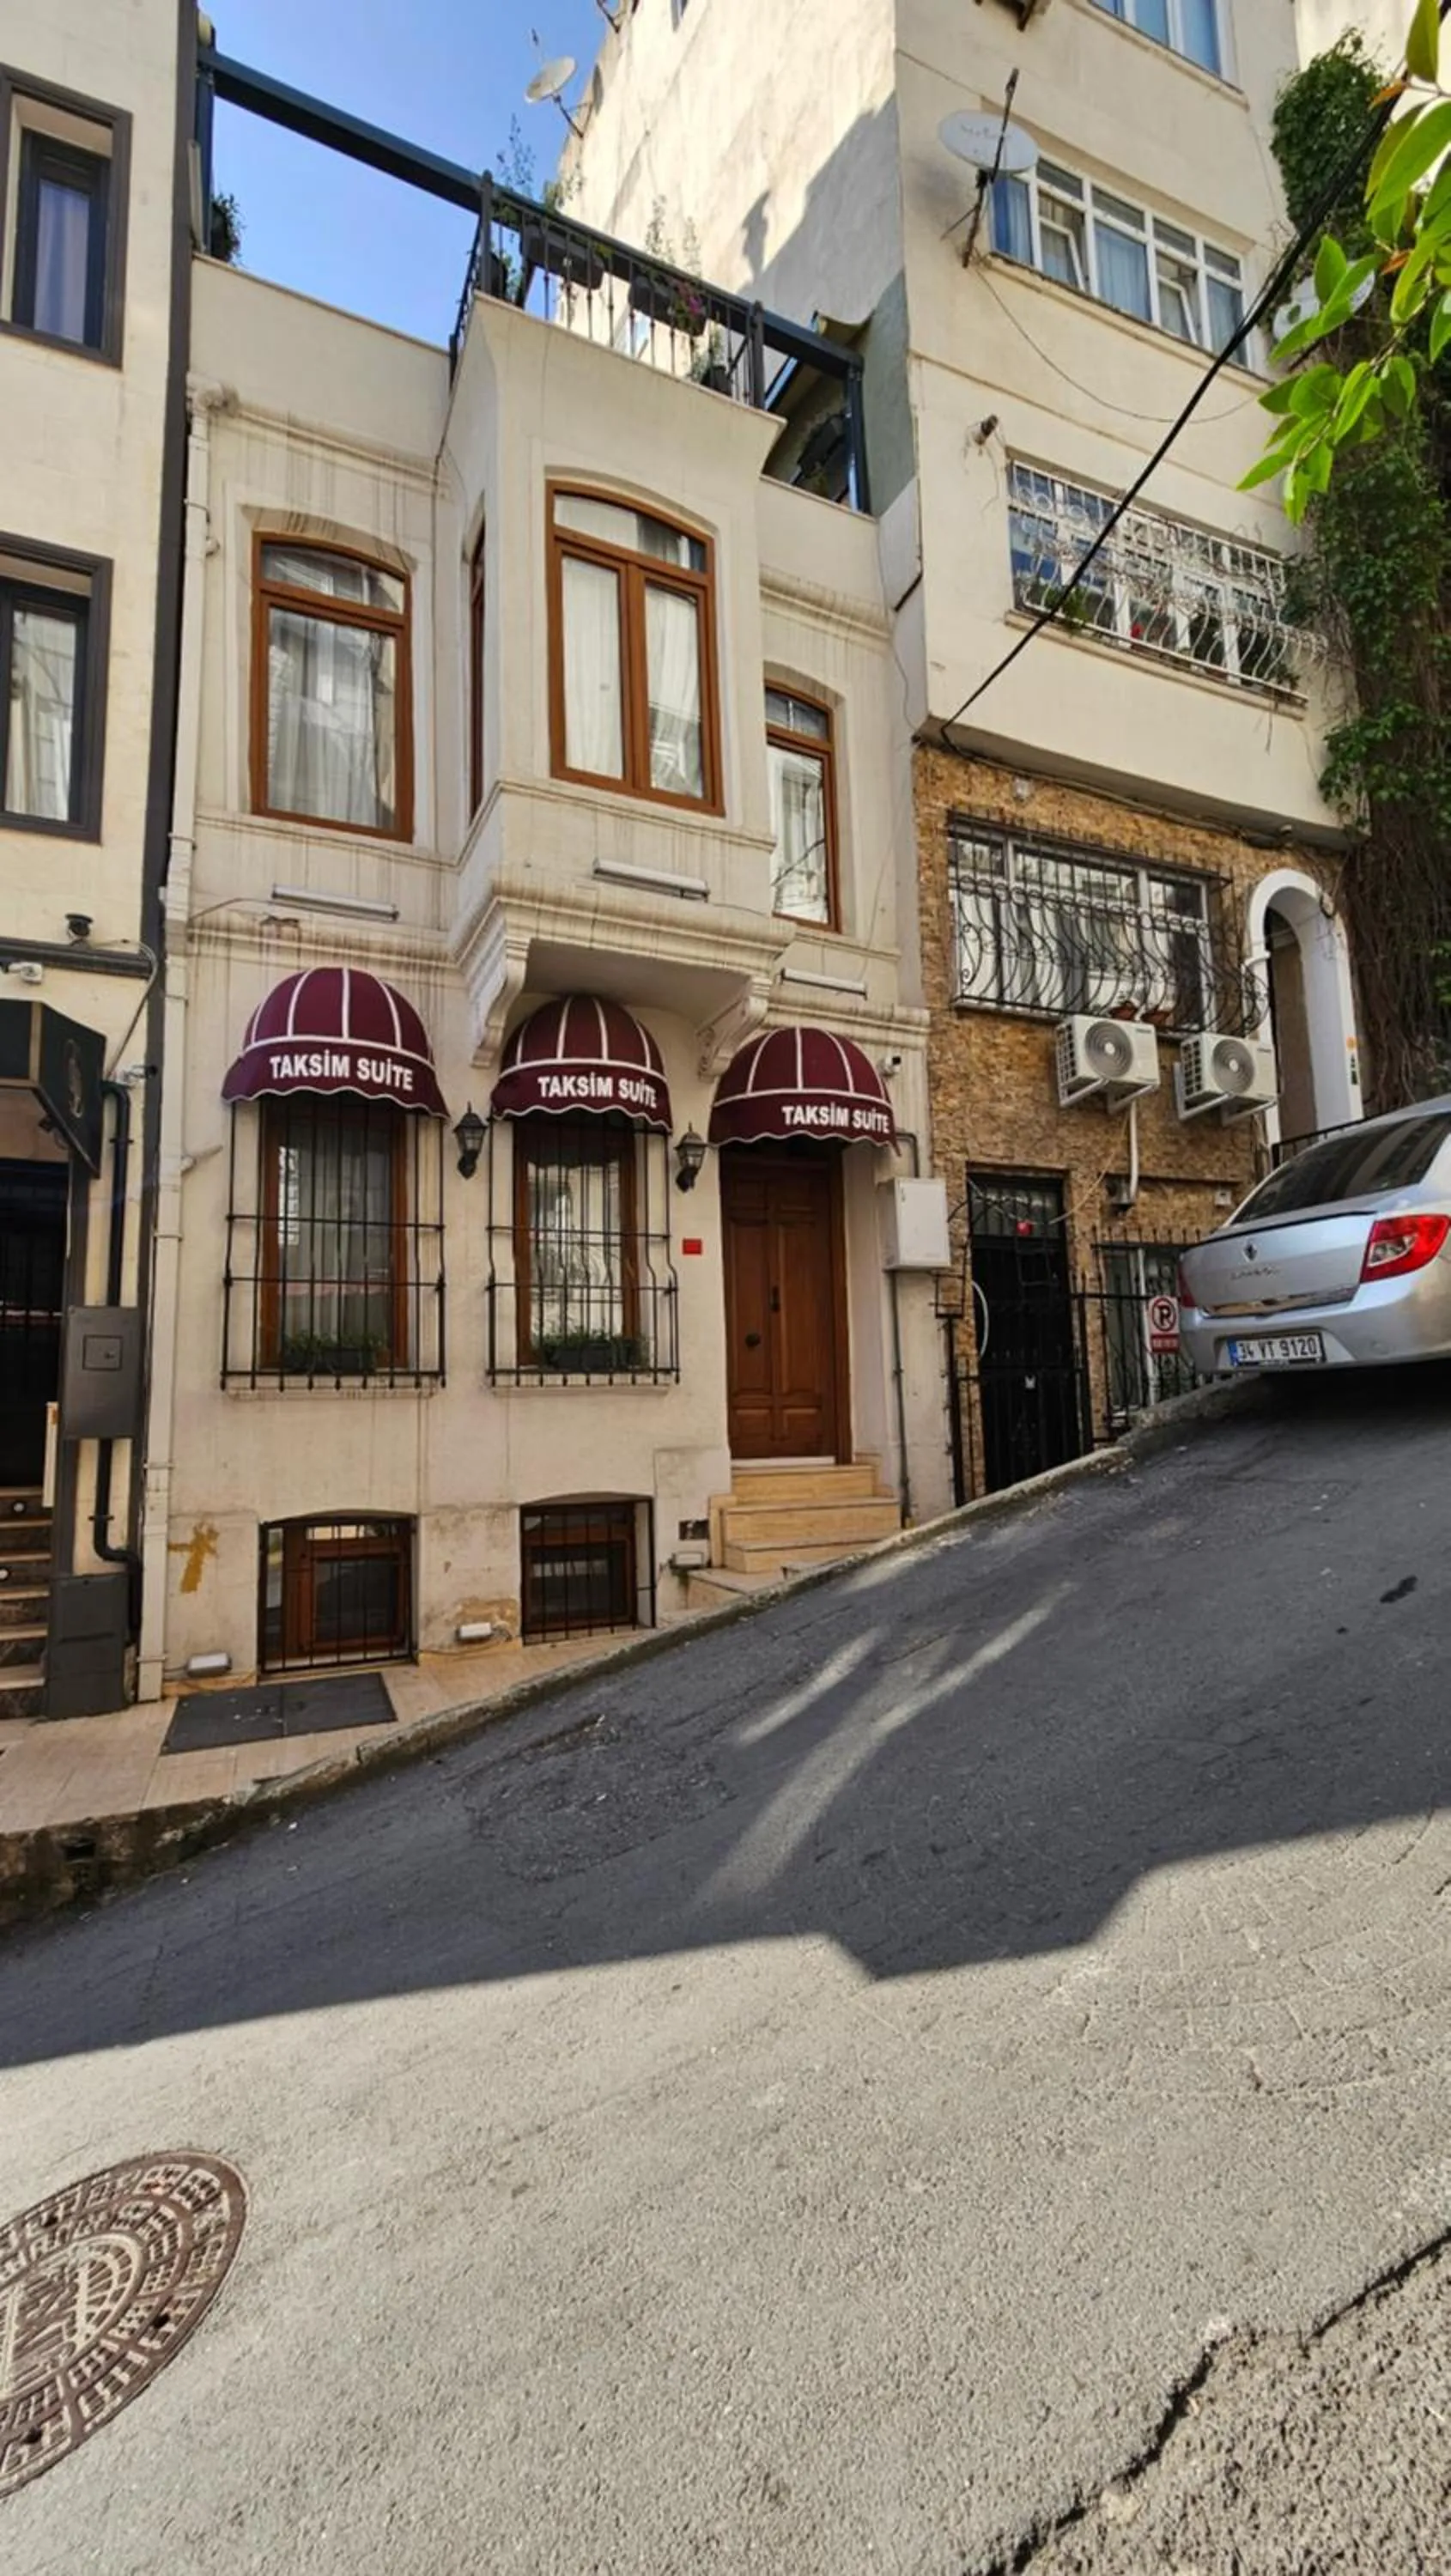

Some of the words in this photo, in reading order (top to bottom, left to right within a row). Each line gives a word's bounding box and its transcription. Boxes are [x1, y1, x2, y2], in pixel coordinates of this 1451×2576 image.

[270, 1048, 349, 1079] TAKSİM
[356, 1058, 414, 1091] SUİTE
[537, 1072, 613, 1098] TAKSİM
[618, 1078, 658, 1109] SUİTE
[781, 1101, 849, 1127] TAKSİM
[853, 1106, 890, 1133] SUİTE
[1279, 1337, 1317, 1357] 9120
